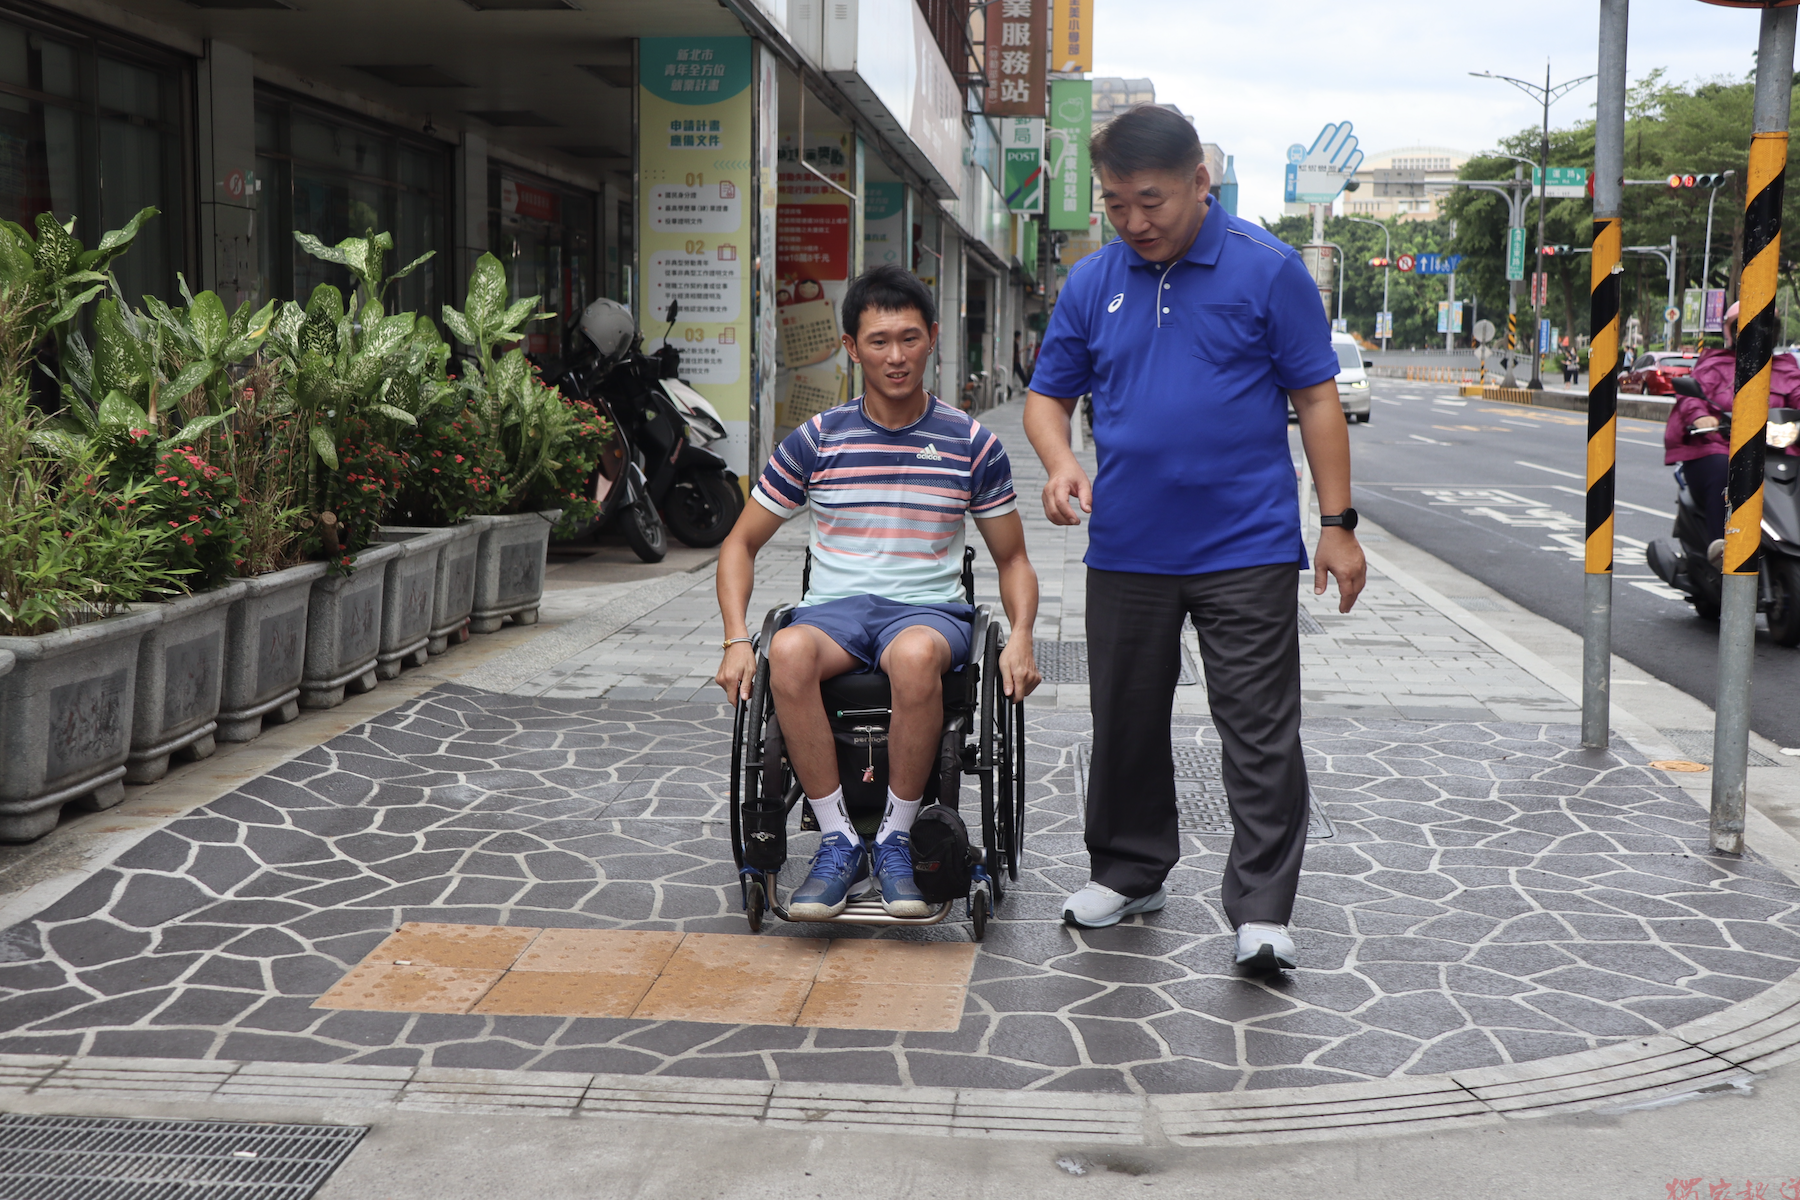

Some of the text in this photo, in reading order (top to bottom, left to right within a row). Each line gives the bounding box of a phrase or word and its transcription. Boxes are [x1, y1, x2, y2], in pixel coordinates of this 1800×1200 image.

[676, 49, 714, 61] 新北市
[1000, 0, 1031, 104] 業服務站
[664, 64, 726, 76] 青年全方位
[670, 79, 720, 92] 就業計畫
[670, 120, 720, 132] 申請計畫
[670, 135, 720, 147] 應備文件
[1008, 152, 1036, 162] POST
[686, 172, 704, 188] 01
[686, 240, 705, 255] 02
[685, 328, 704, 342] 03
[916, 453, 942, 461] adidas
